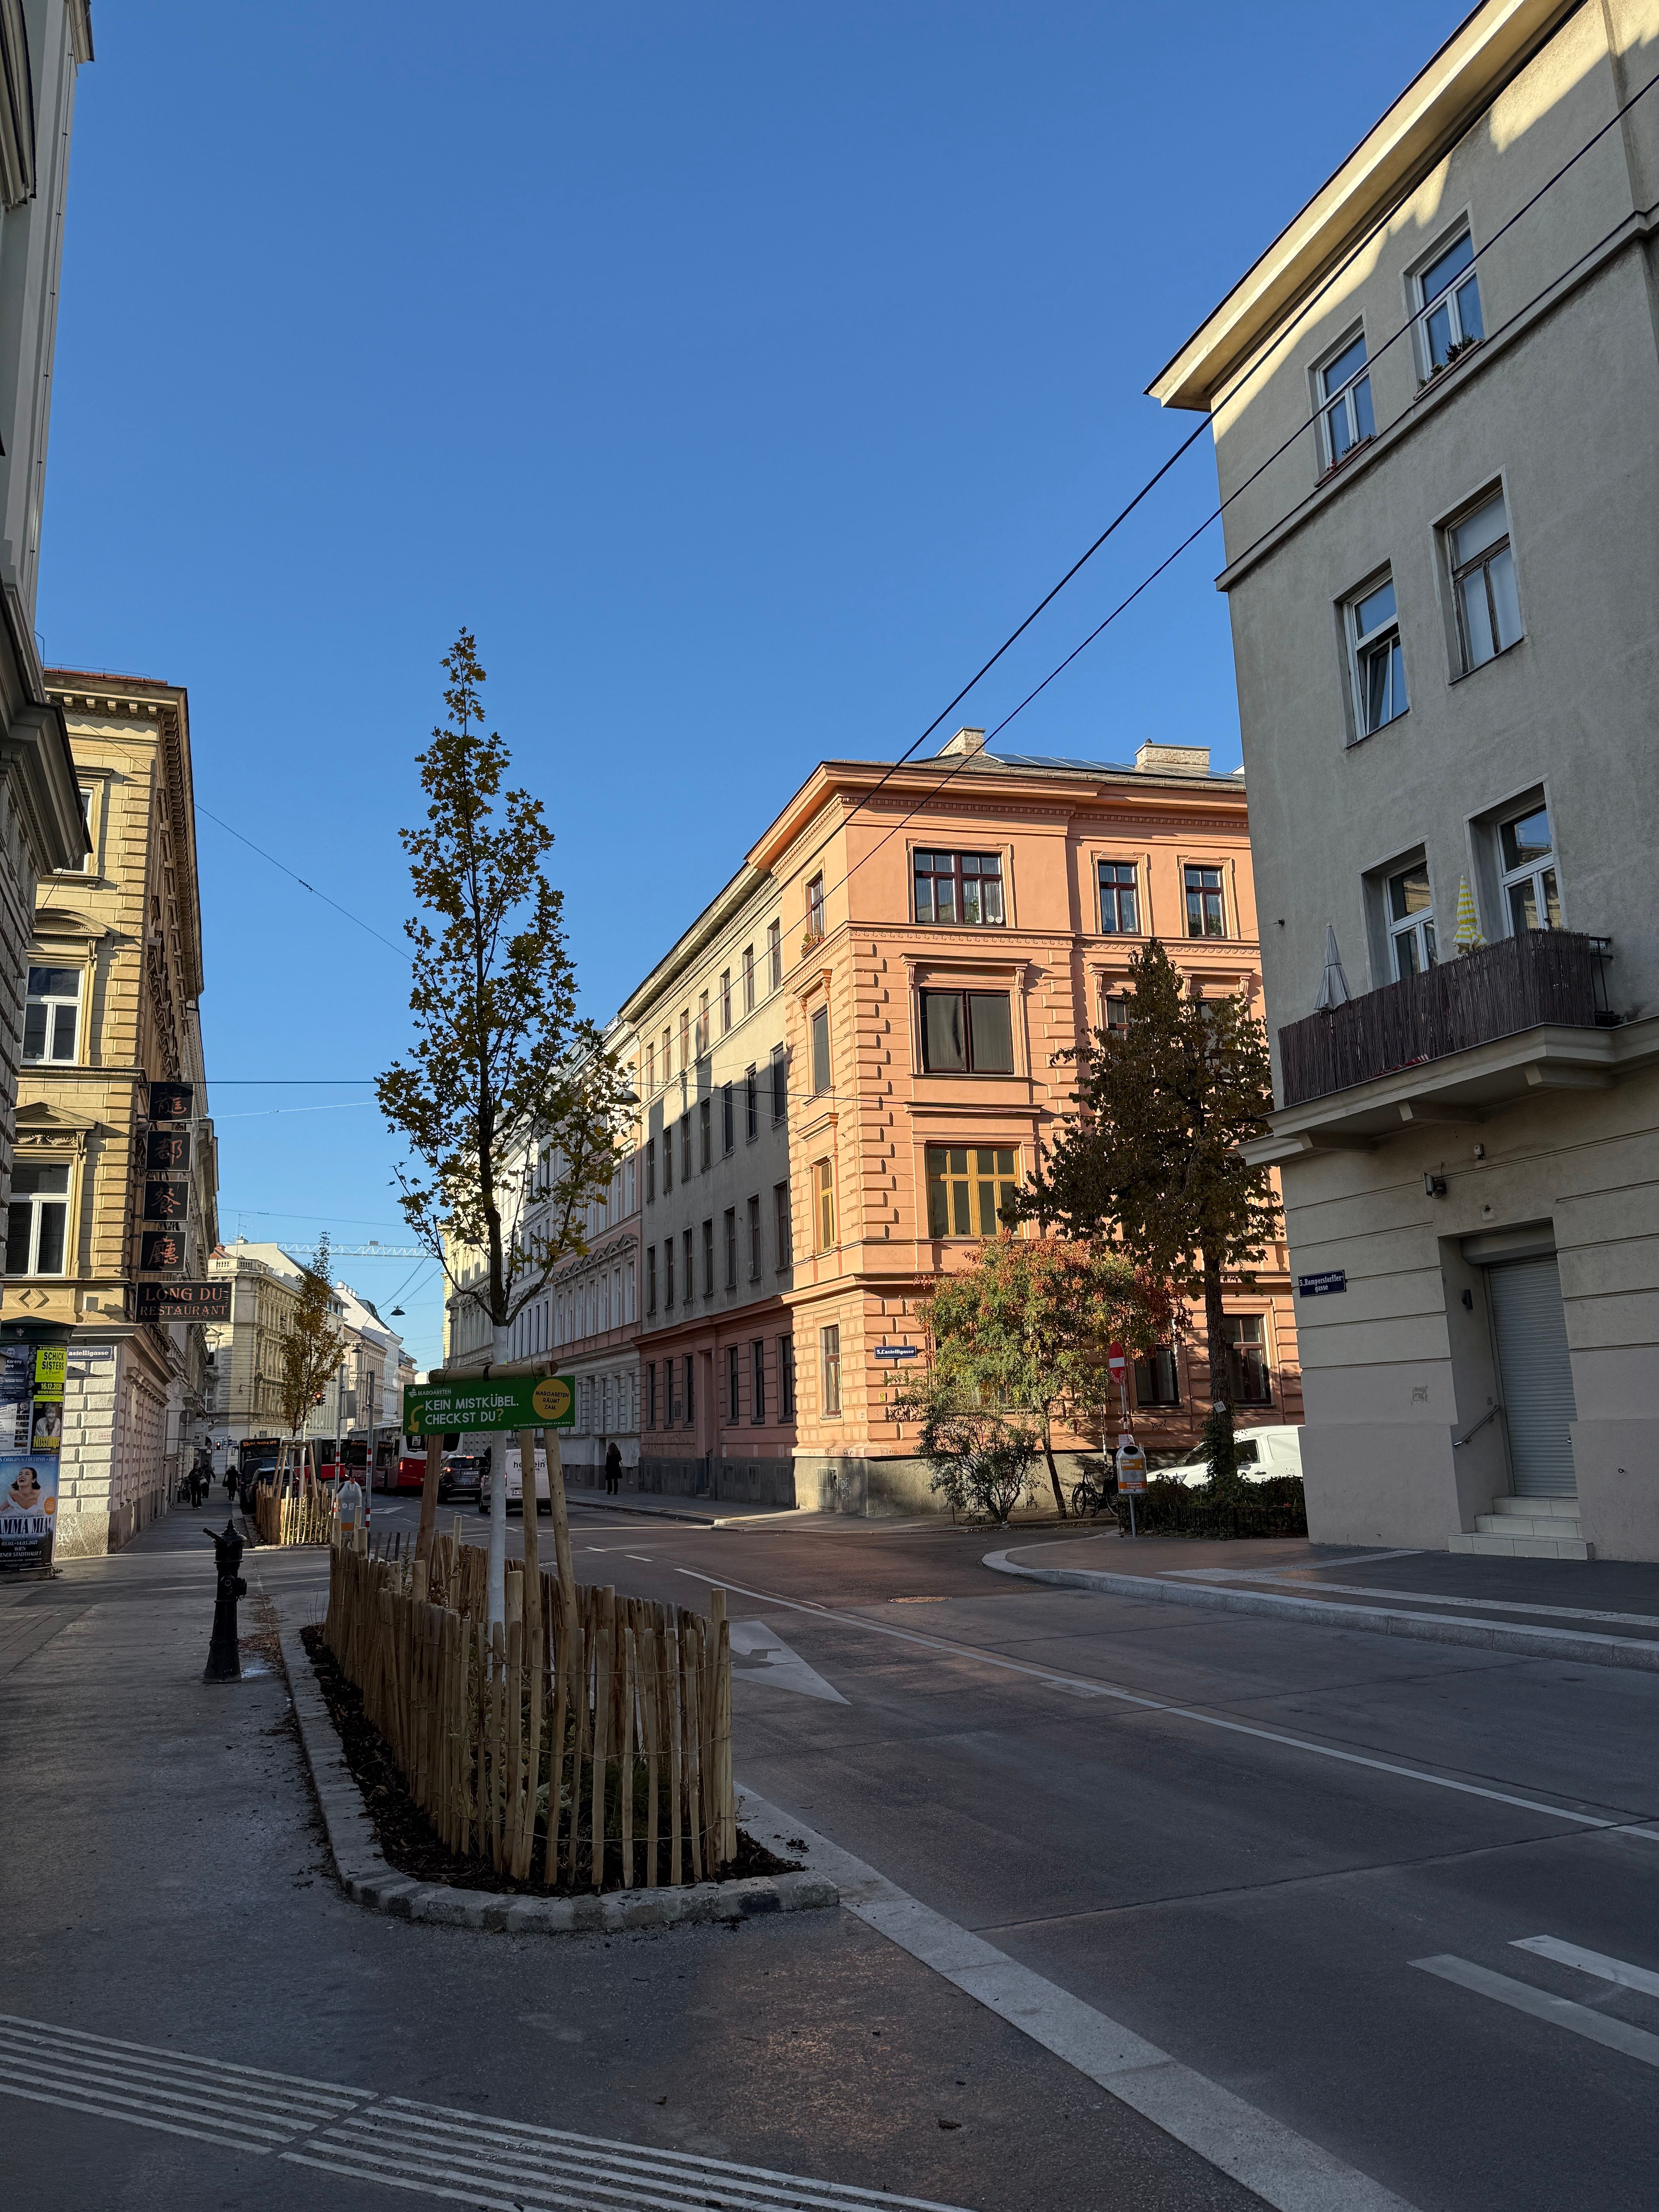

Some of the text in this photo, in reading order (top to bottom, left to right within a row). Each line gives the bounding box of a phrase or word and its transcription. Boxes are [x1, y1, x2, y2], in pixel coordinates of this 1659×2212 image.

[145, 1288, 223, 1302] LONG DU
[140, 1305, 227, 1316] RESTAURANT
[44, 1352, 64, 1361] SCHICK
[42, 1361, 64, 1370] SISTERS
[425, 1393, 519, 1411] KEIN MISTKÜBEL.
[425, 1408, 504, 1425] CHECKST DU?
[0, 1517, 51, 1535] AMMA MIA!
